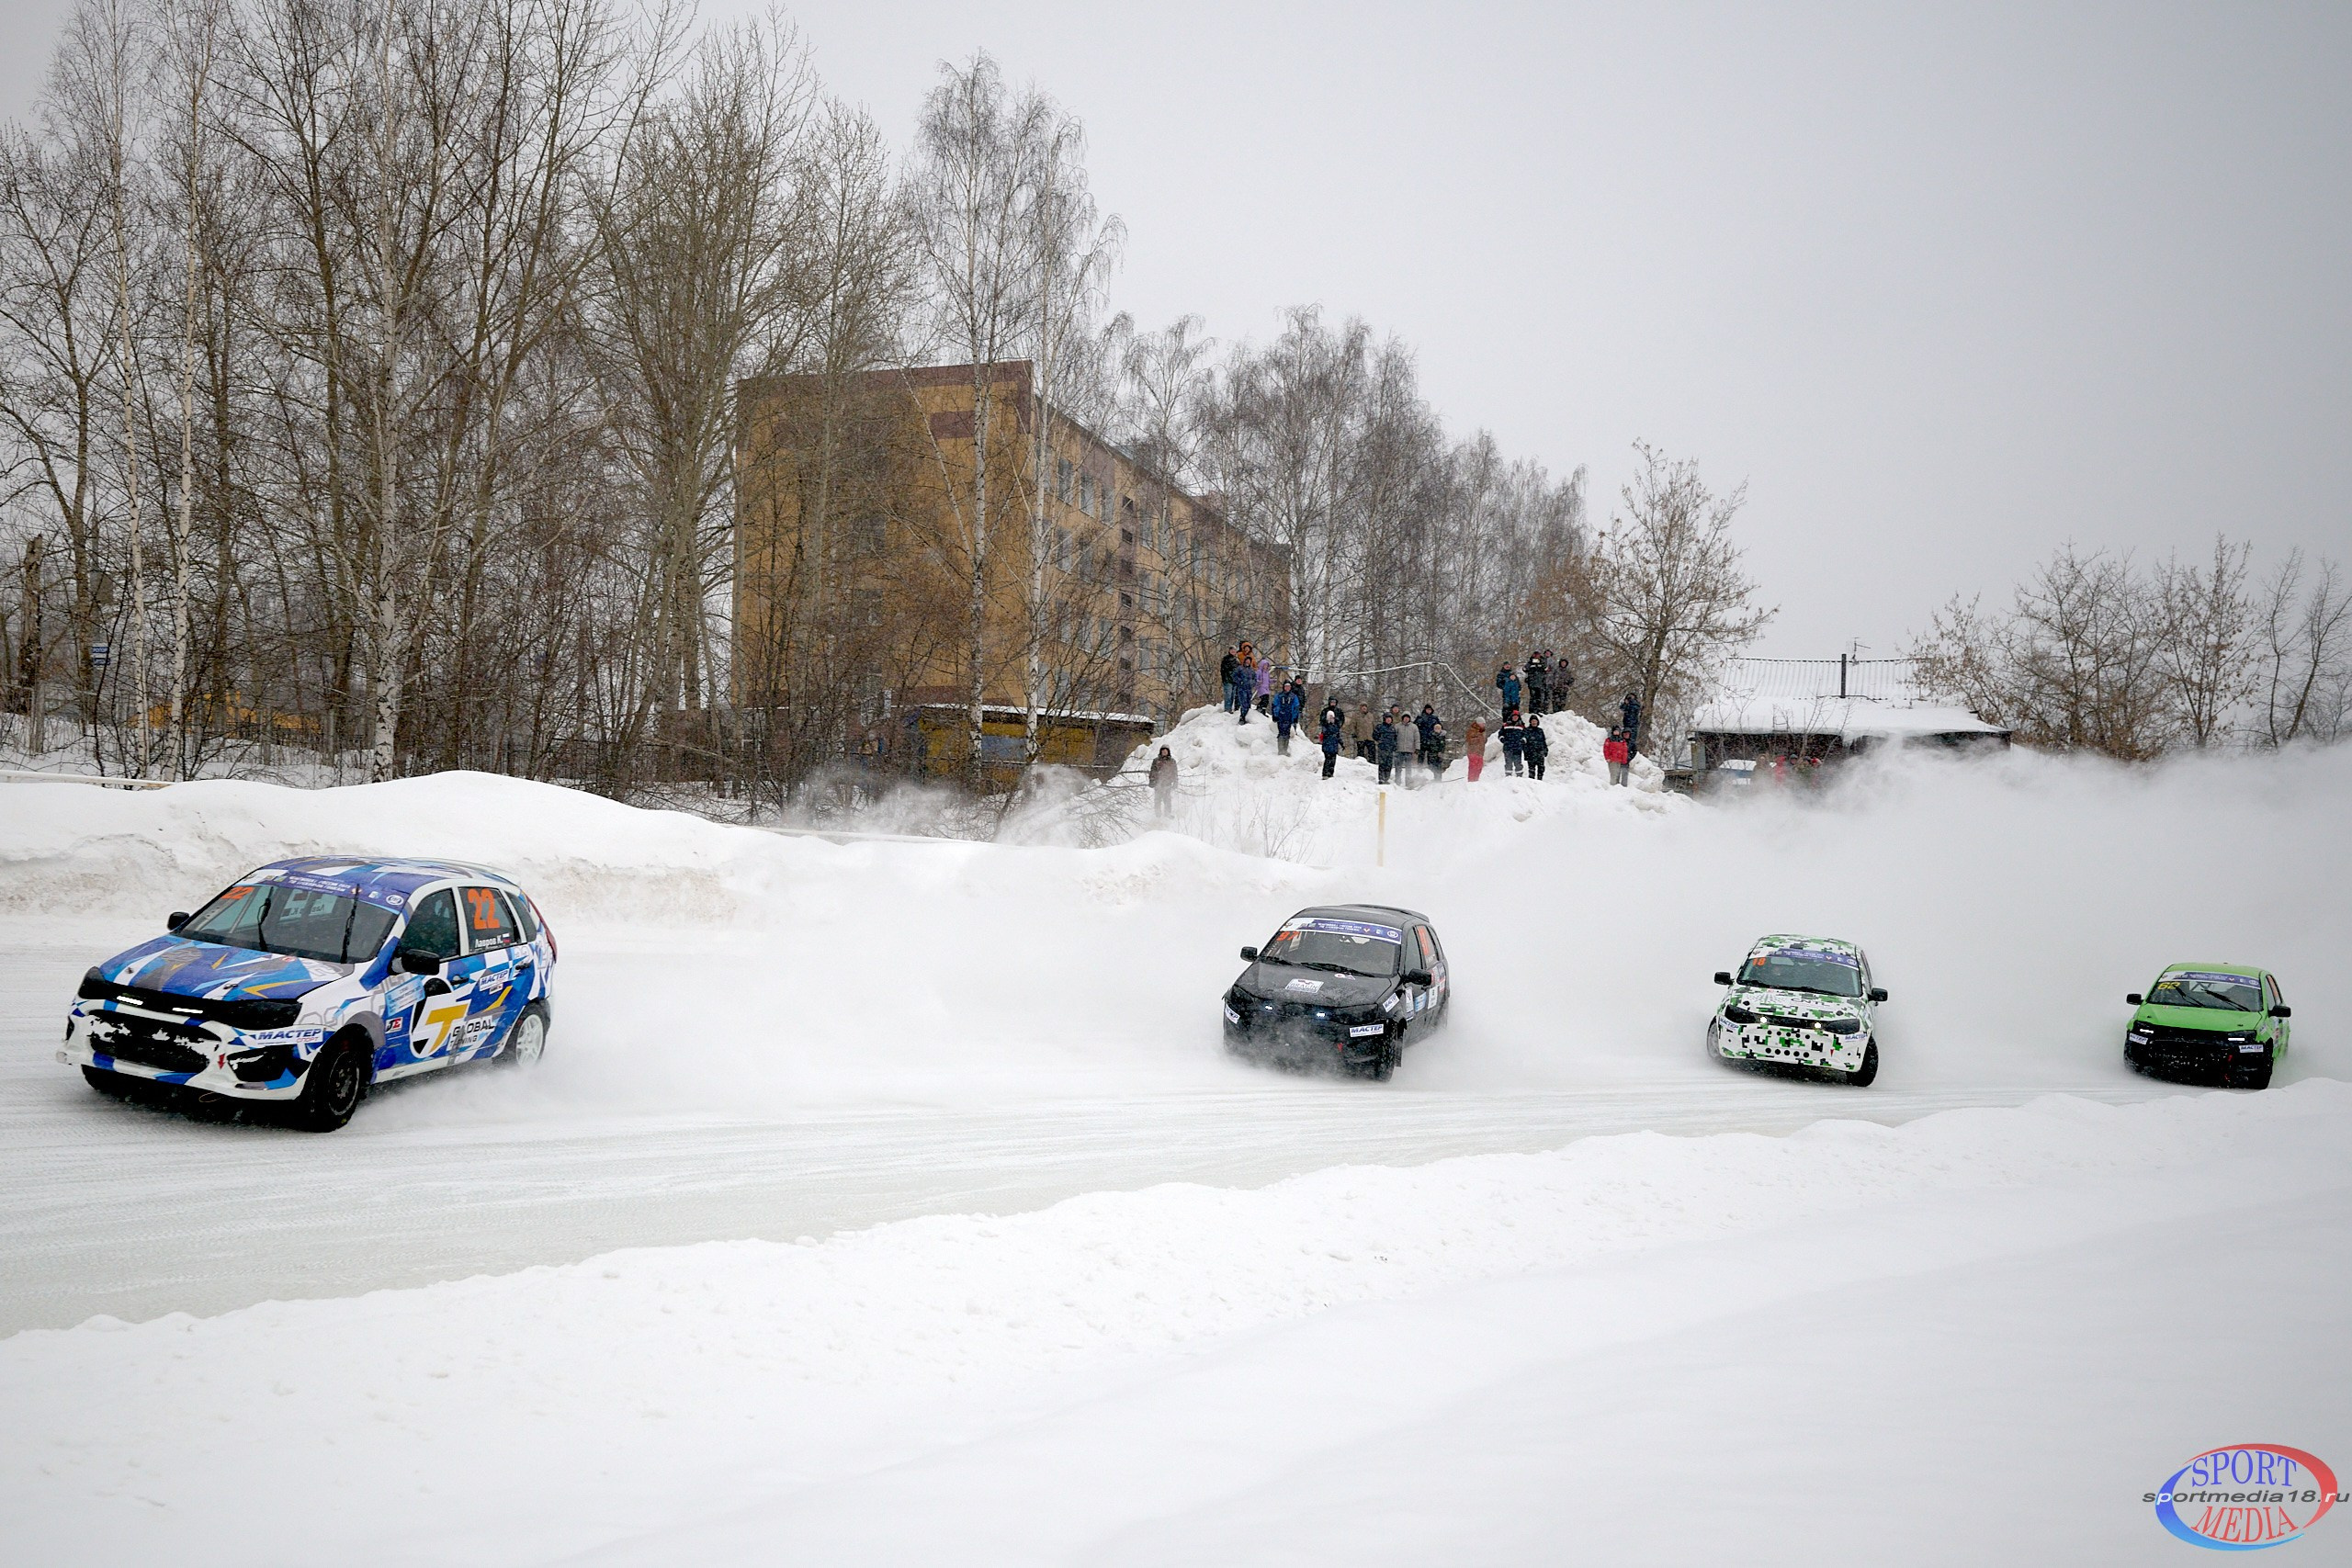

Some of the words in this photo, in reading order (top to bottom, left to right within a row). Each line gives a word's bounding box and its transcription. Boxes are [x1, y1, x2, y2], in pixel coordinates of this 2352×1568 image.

[467, 887, 501, 931] 22
[1752, 956, 1766, 966] 18
[481, 969, 509, 986] МАСТЕР
[2157, 981, 2181, 990] 62
[257, 1028, 322, 1040] МАСТЕР
[452, 1019, 495, 1037] GOBAL
[1351, 1025, 1383, 1034] МАСТЕР
